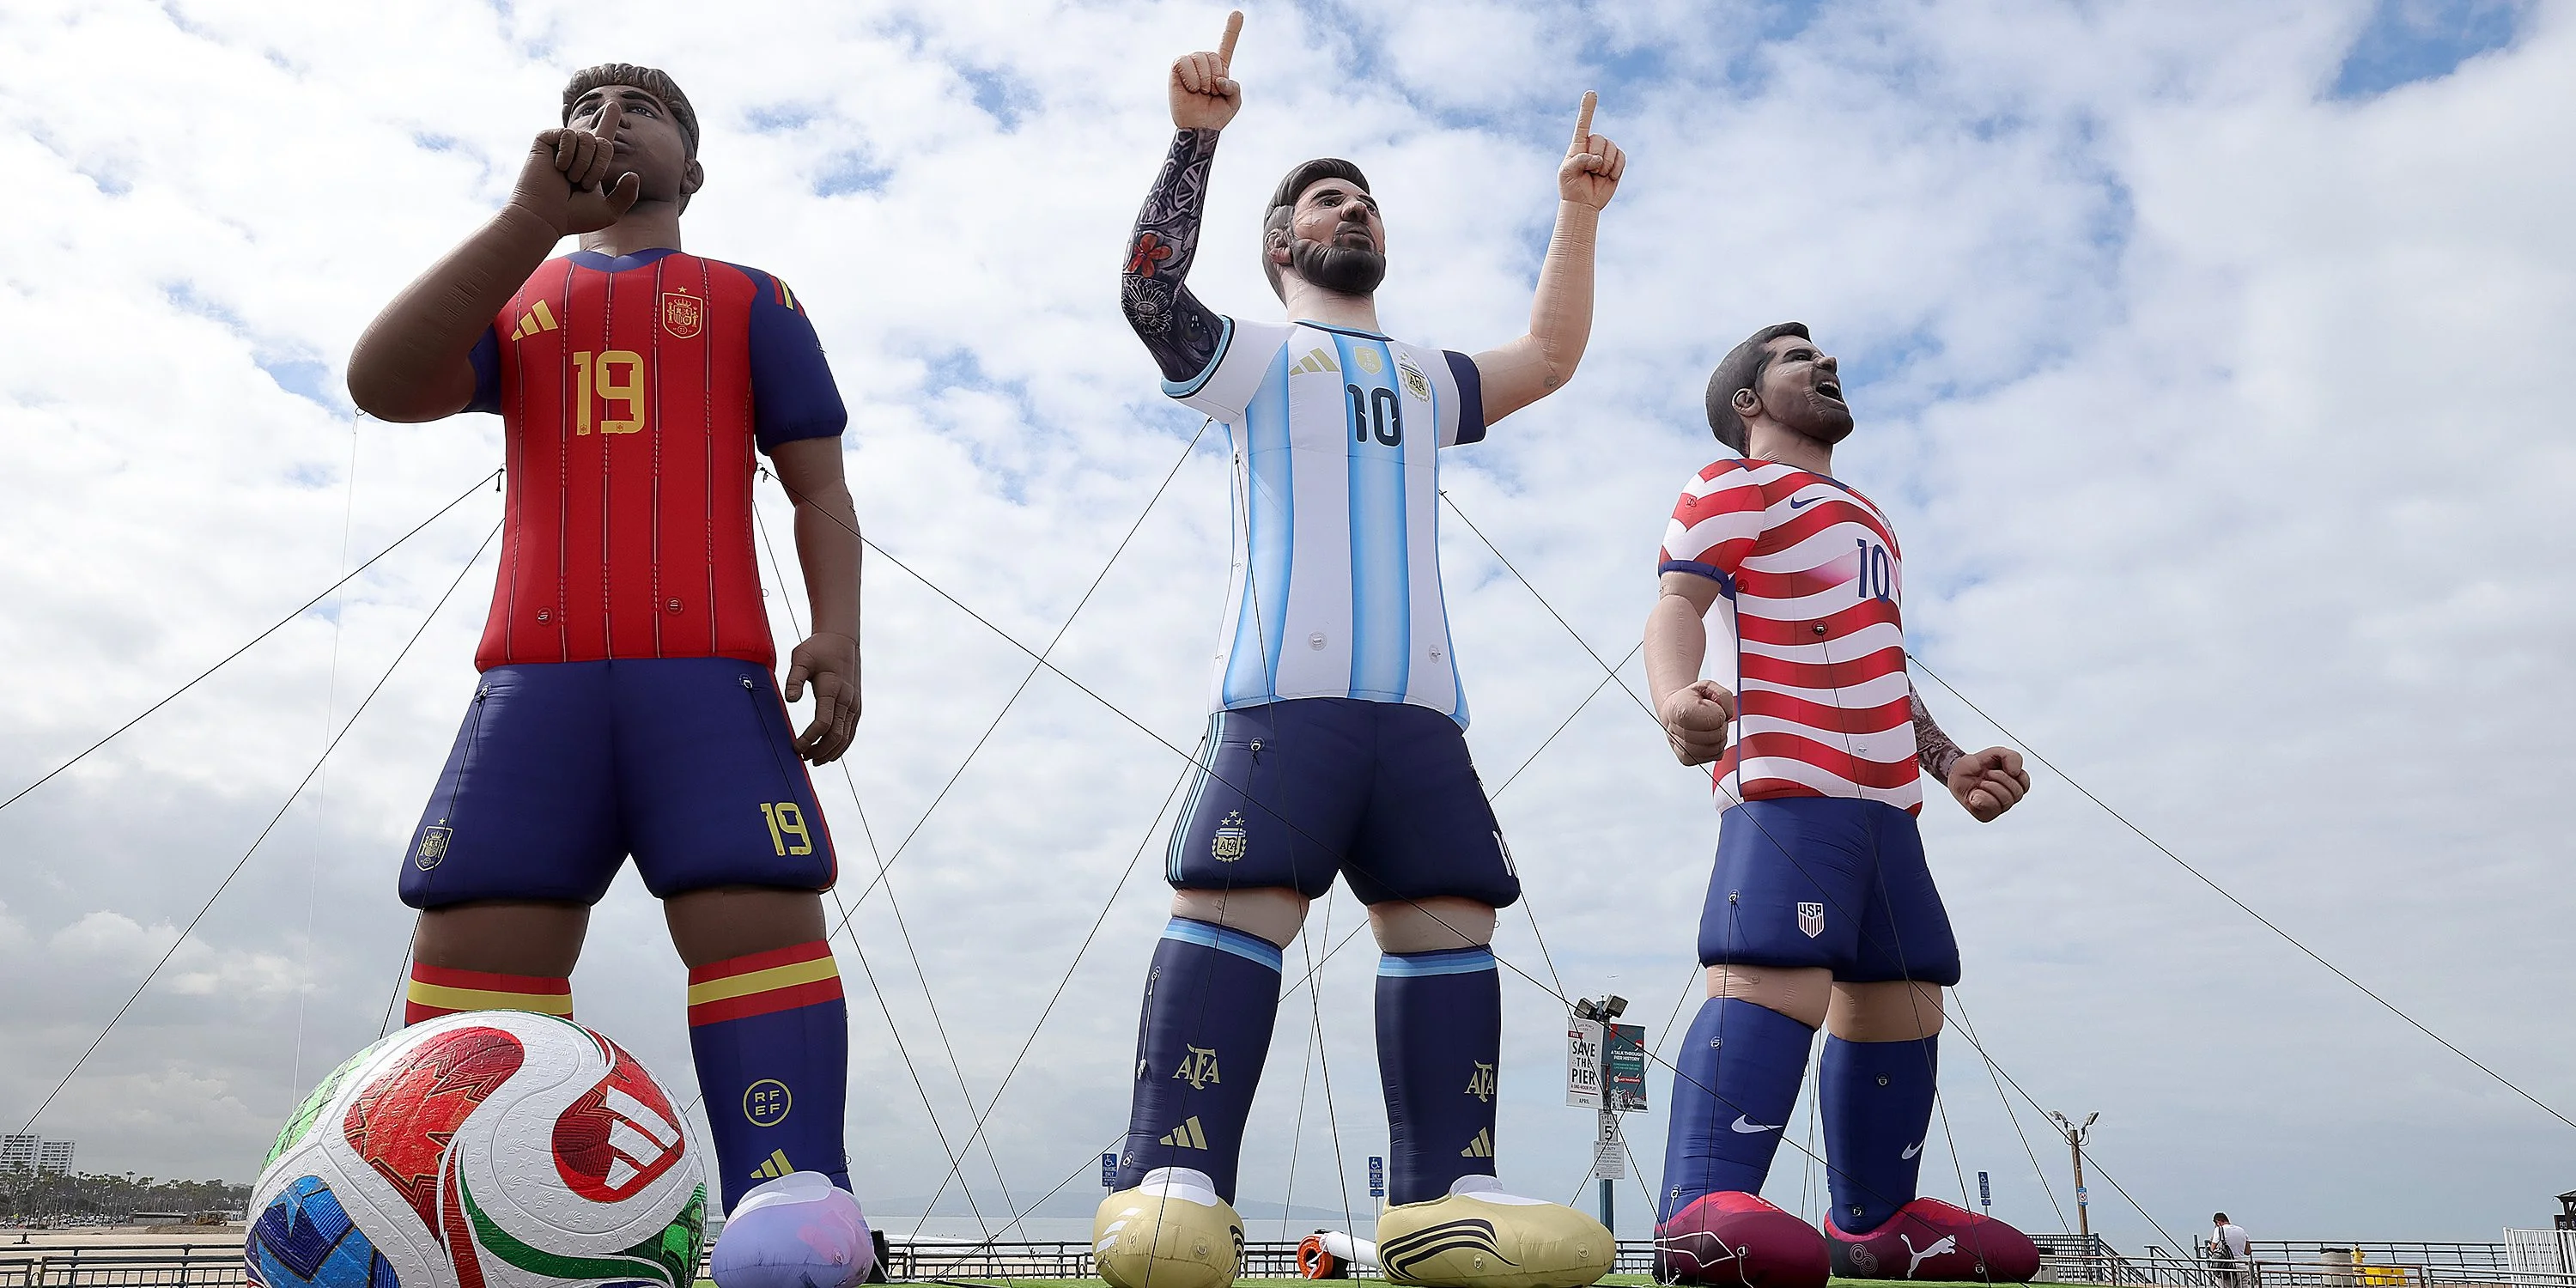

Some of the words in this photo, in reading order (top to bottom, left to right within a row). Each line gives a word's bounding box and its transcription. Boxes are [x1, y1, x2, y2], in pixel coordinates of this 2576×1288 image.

[573, 350, 645, 435] 19
[1346, 383, 1402, 447] 10
[1856, 538, 1890, 605] 10
[760, 802, 812, 856] 19
[1218, 837, 1237, 853] AFA
[1799, 903, 1822, 918] USA
[1572, 1041, 1595, 1057] SAVE
[1172, 1043, 1220, 1090] AFA
[1464, 1060, 1494, 1103] AFA
[1572, 1068, 1595, 1085] PIER
[755, 1090, 780, 1103] RF
[756, 1103, 780, 1116] EF
[1605, 1126, 1613, 1139] 5
